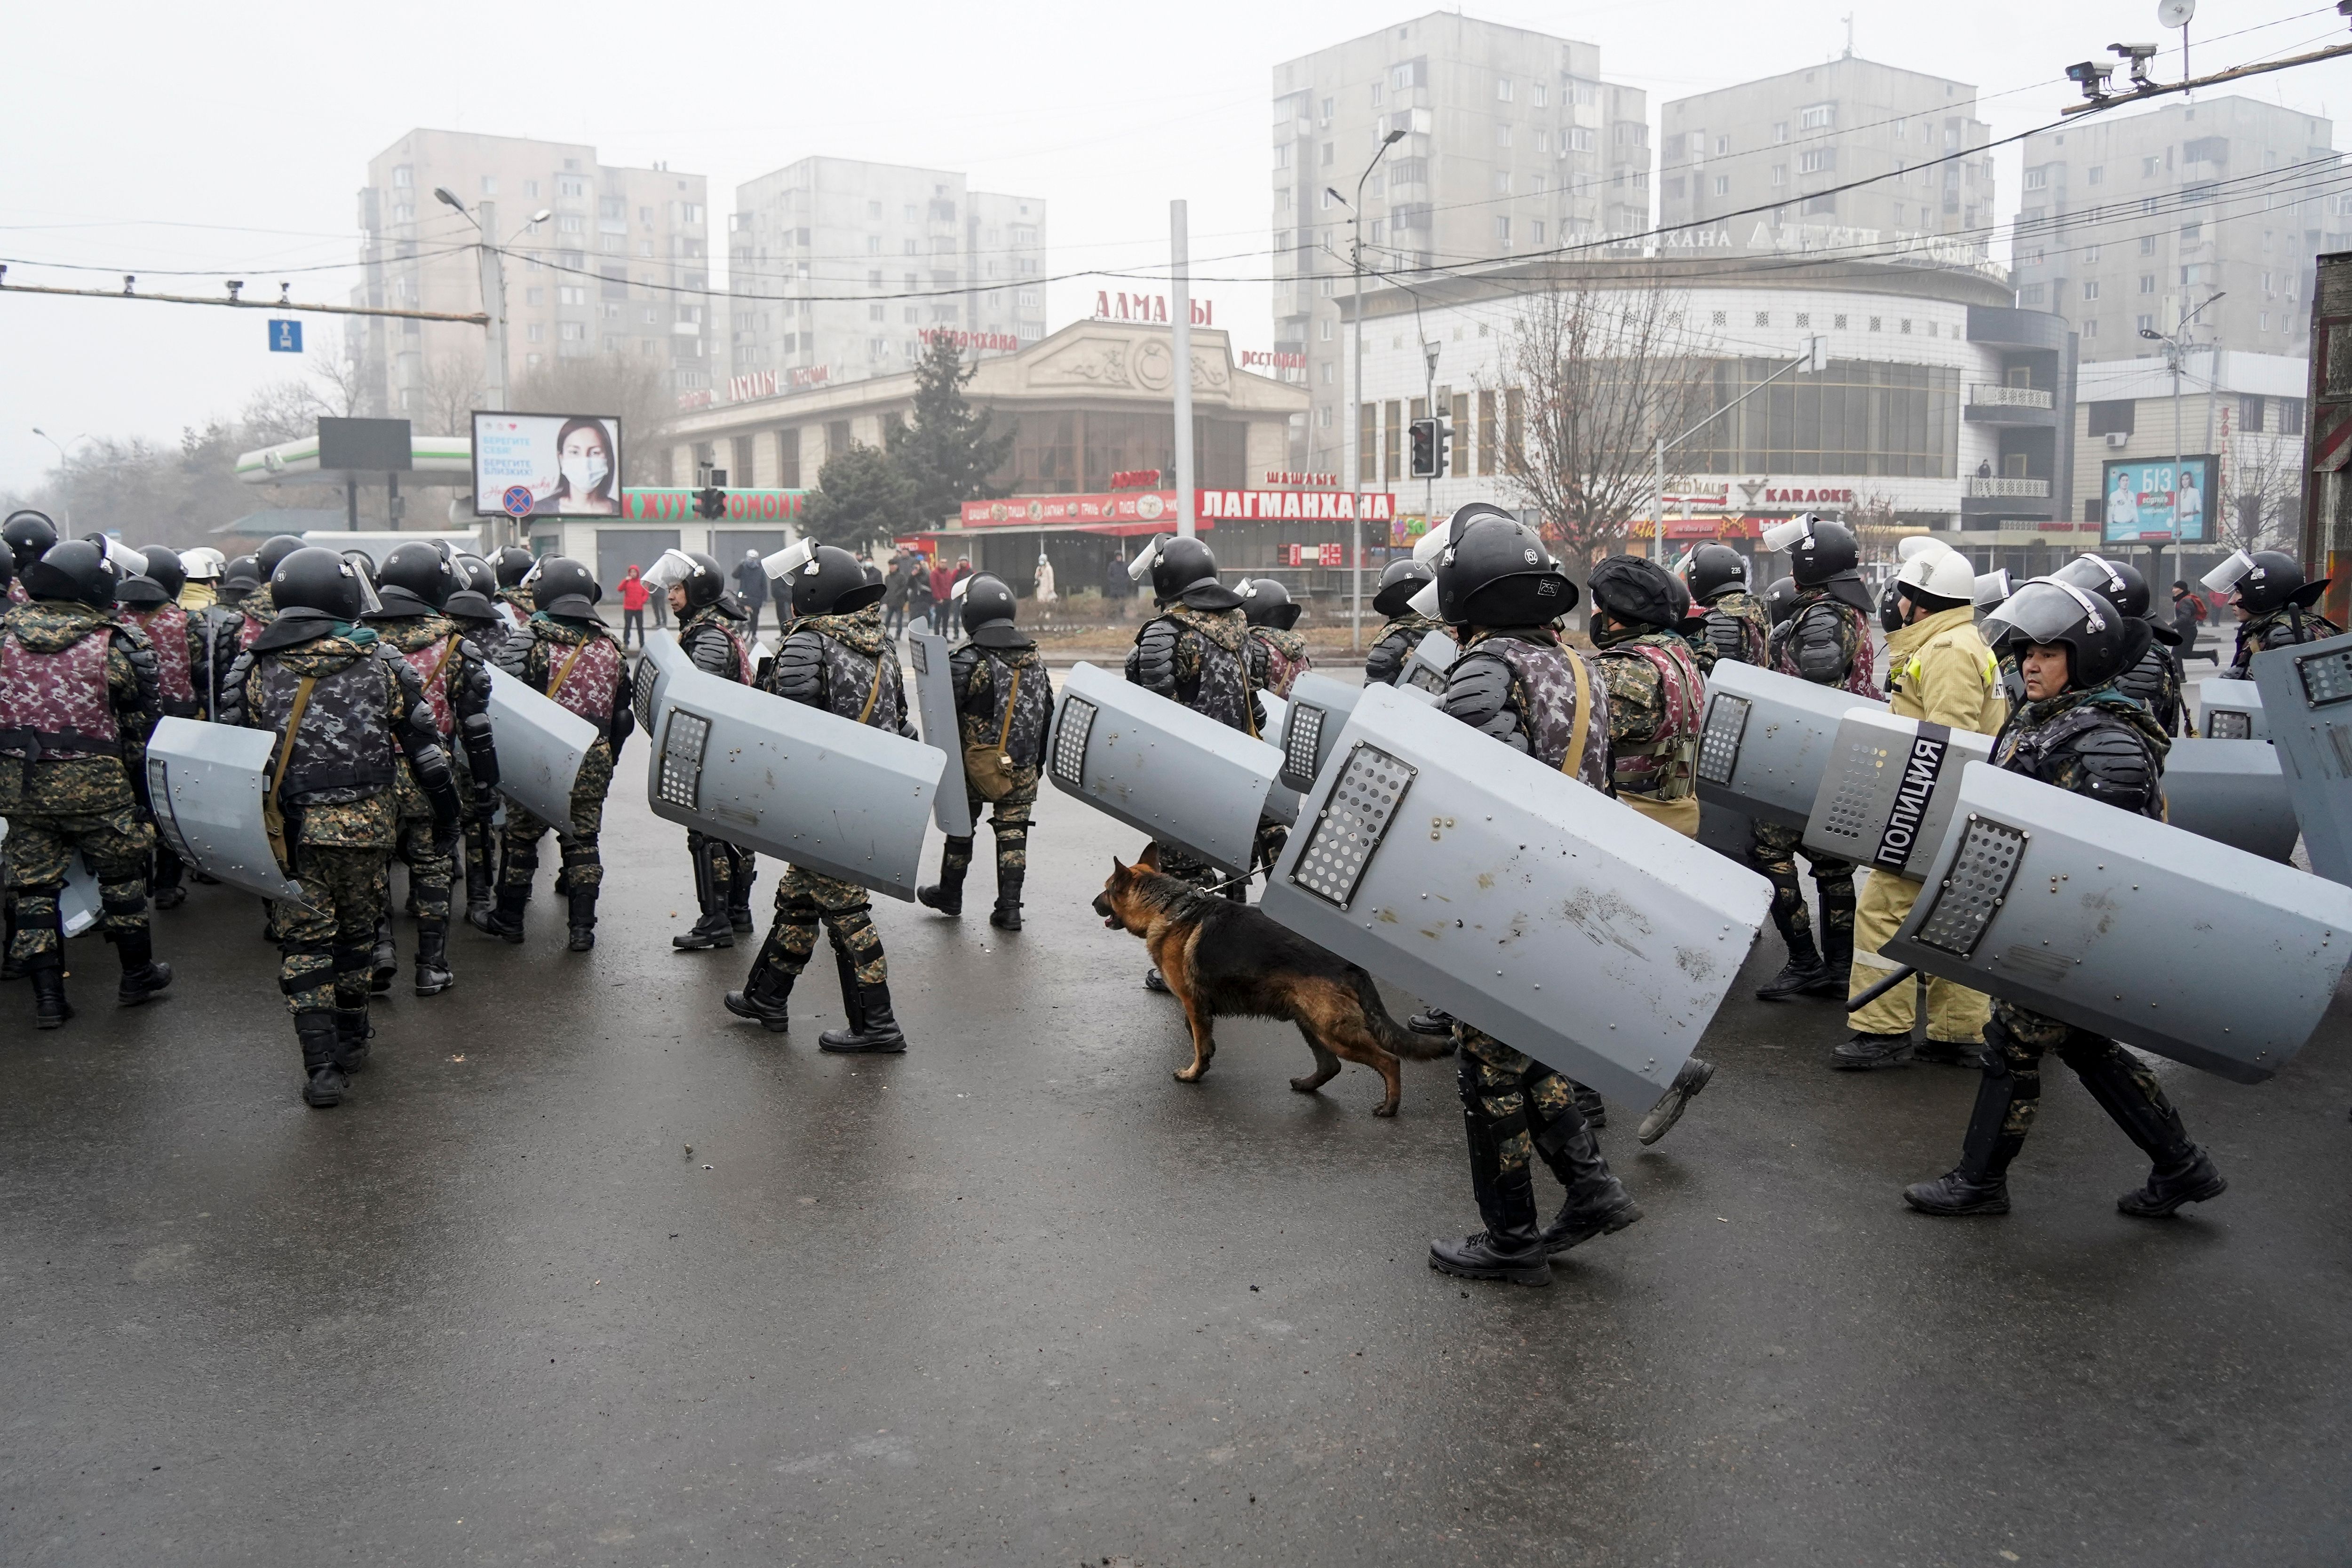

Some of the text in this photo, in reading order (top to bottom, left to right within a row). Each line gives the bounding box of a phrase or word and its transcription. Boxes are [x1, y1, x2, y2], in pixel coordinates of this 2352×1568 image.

[1096, 291, 1212, 325] АЛМАЫ
[1265, 471, 1337, 485] ШАШЛЫК
[640, 493, 687, 519] ЖУУ
[1202, 491, 1390, 519] ЛАГМАНХАНА
[1765, 489, 1852, 503] KARAOKE
[1877, 738, 1942, 864] ПОЛИЦИЯ
